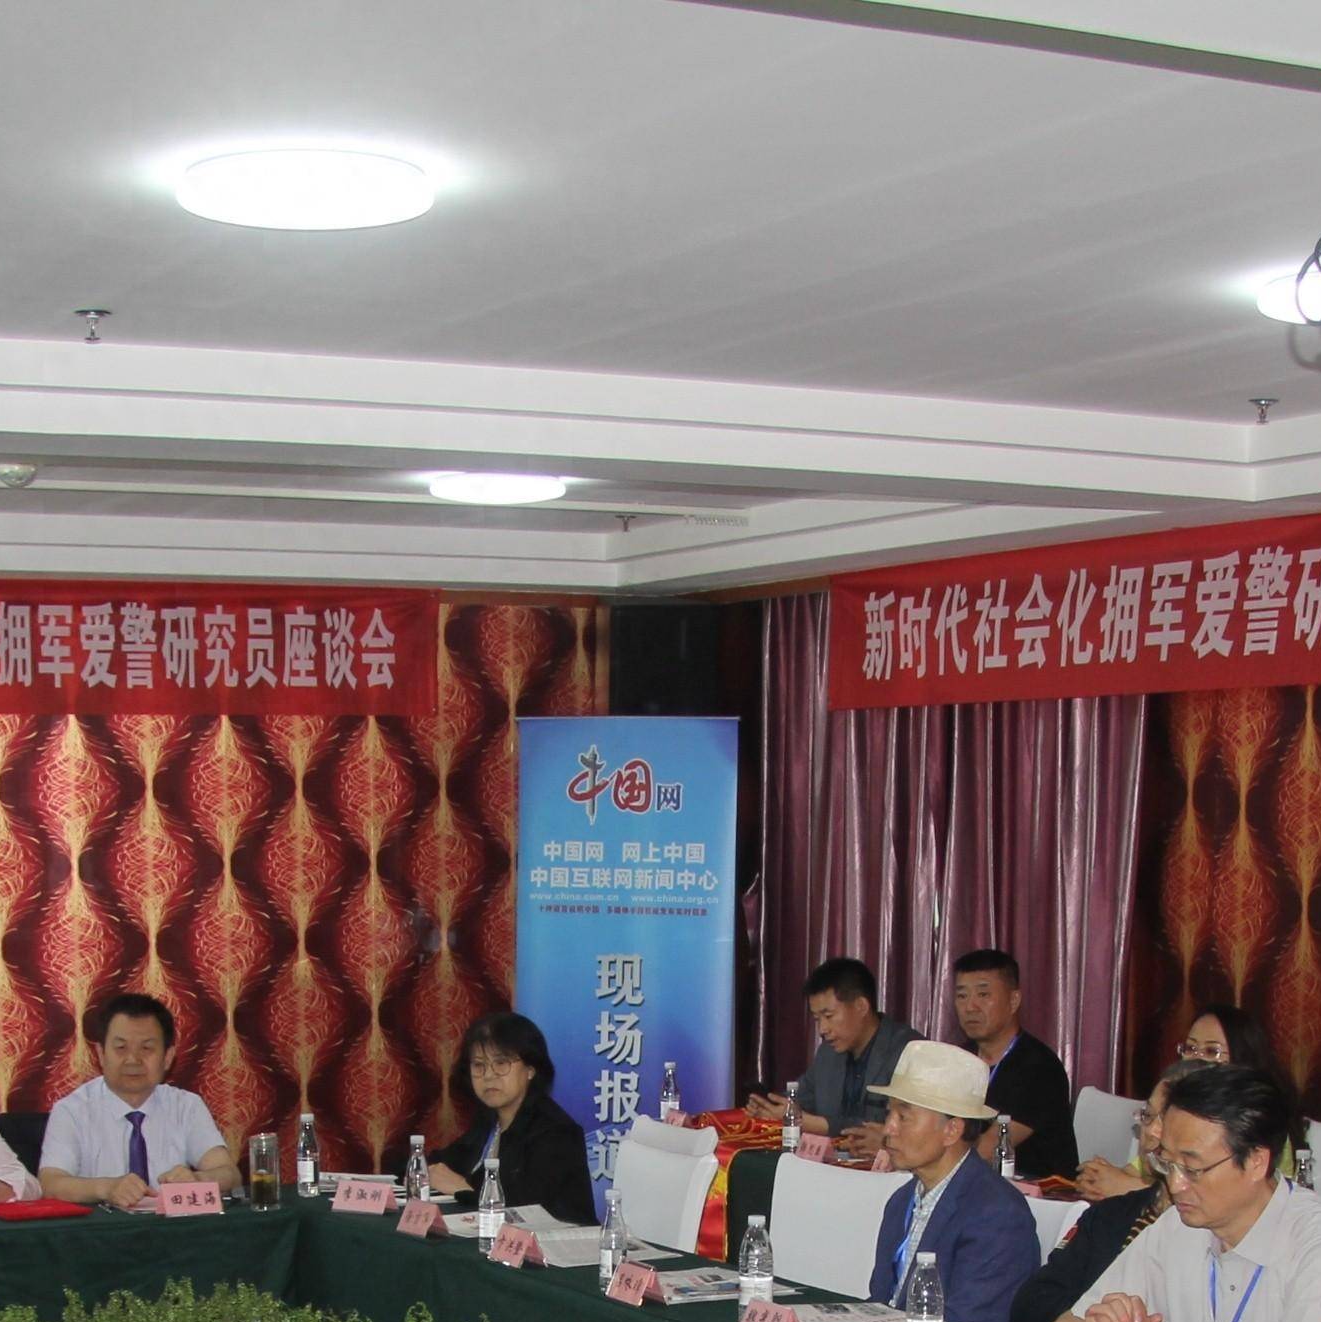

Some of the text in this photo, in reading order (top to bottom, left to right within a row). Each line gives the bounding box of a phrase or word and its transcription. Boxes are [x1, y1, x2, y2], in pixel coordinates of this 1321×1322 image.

[543, 840, 705, 864] 中国网 网上中国
[530, 867, 719, 891] 中国互联网新闻中心
